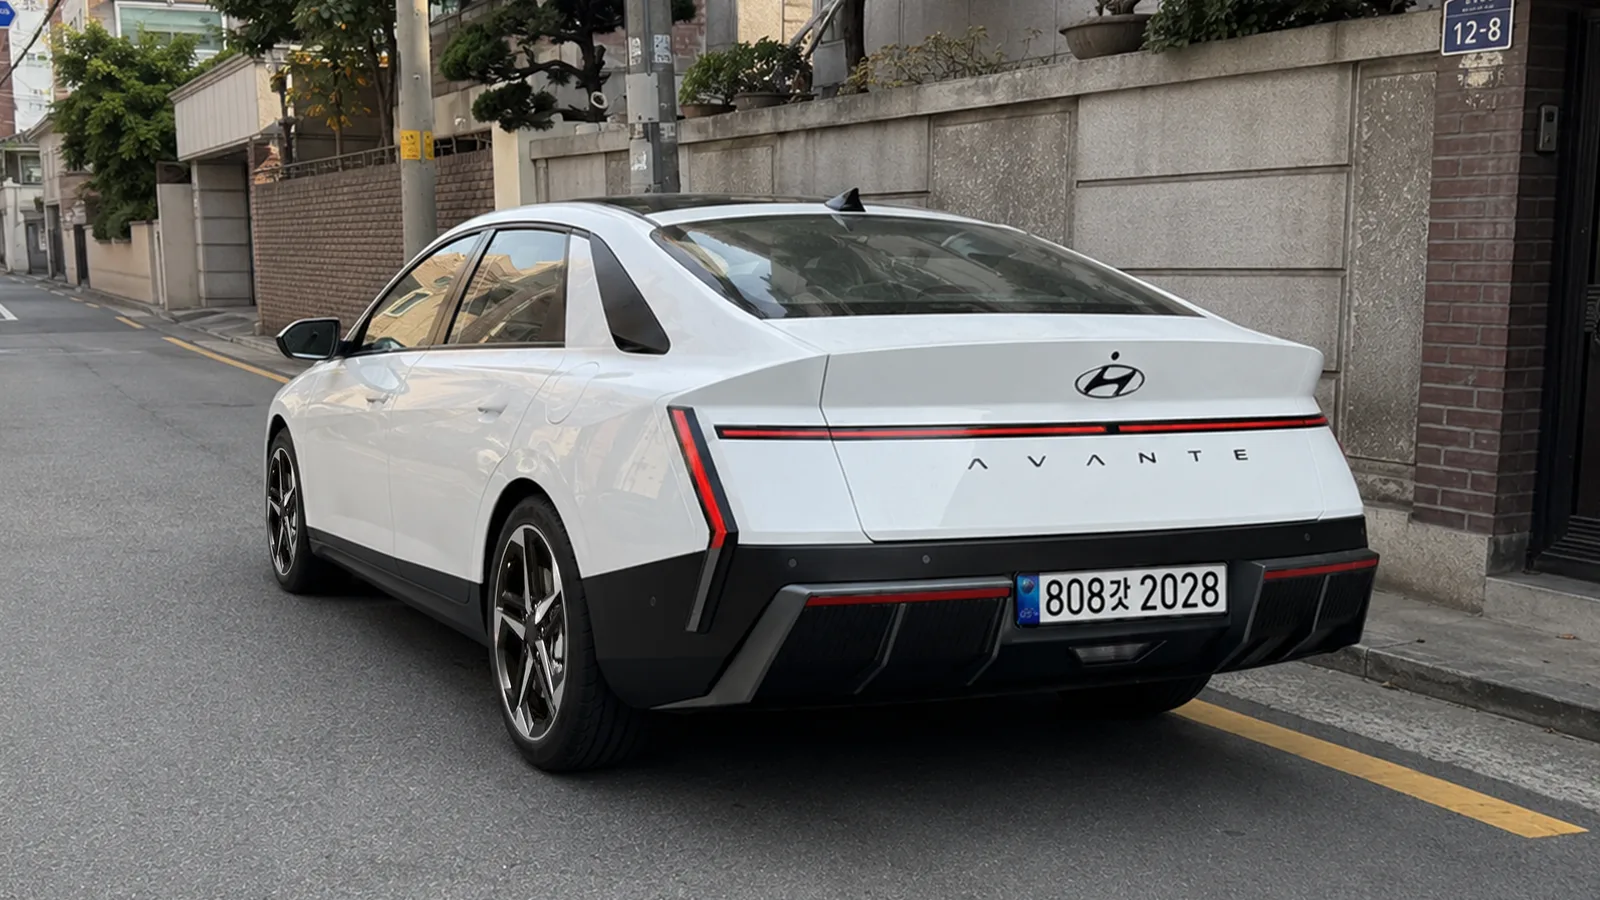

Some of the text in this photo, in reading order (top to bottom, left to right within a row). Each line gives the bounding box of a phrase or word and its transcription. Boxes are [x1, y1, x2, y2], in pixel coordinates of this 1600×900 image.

[1453, 17, 1501, 45] 12-8
[968, 449, 1249, 470] AVANTE
[1046, 571, 1220, 617] 808갓 2028
